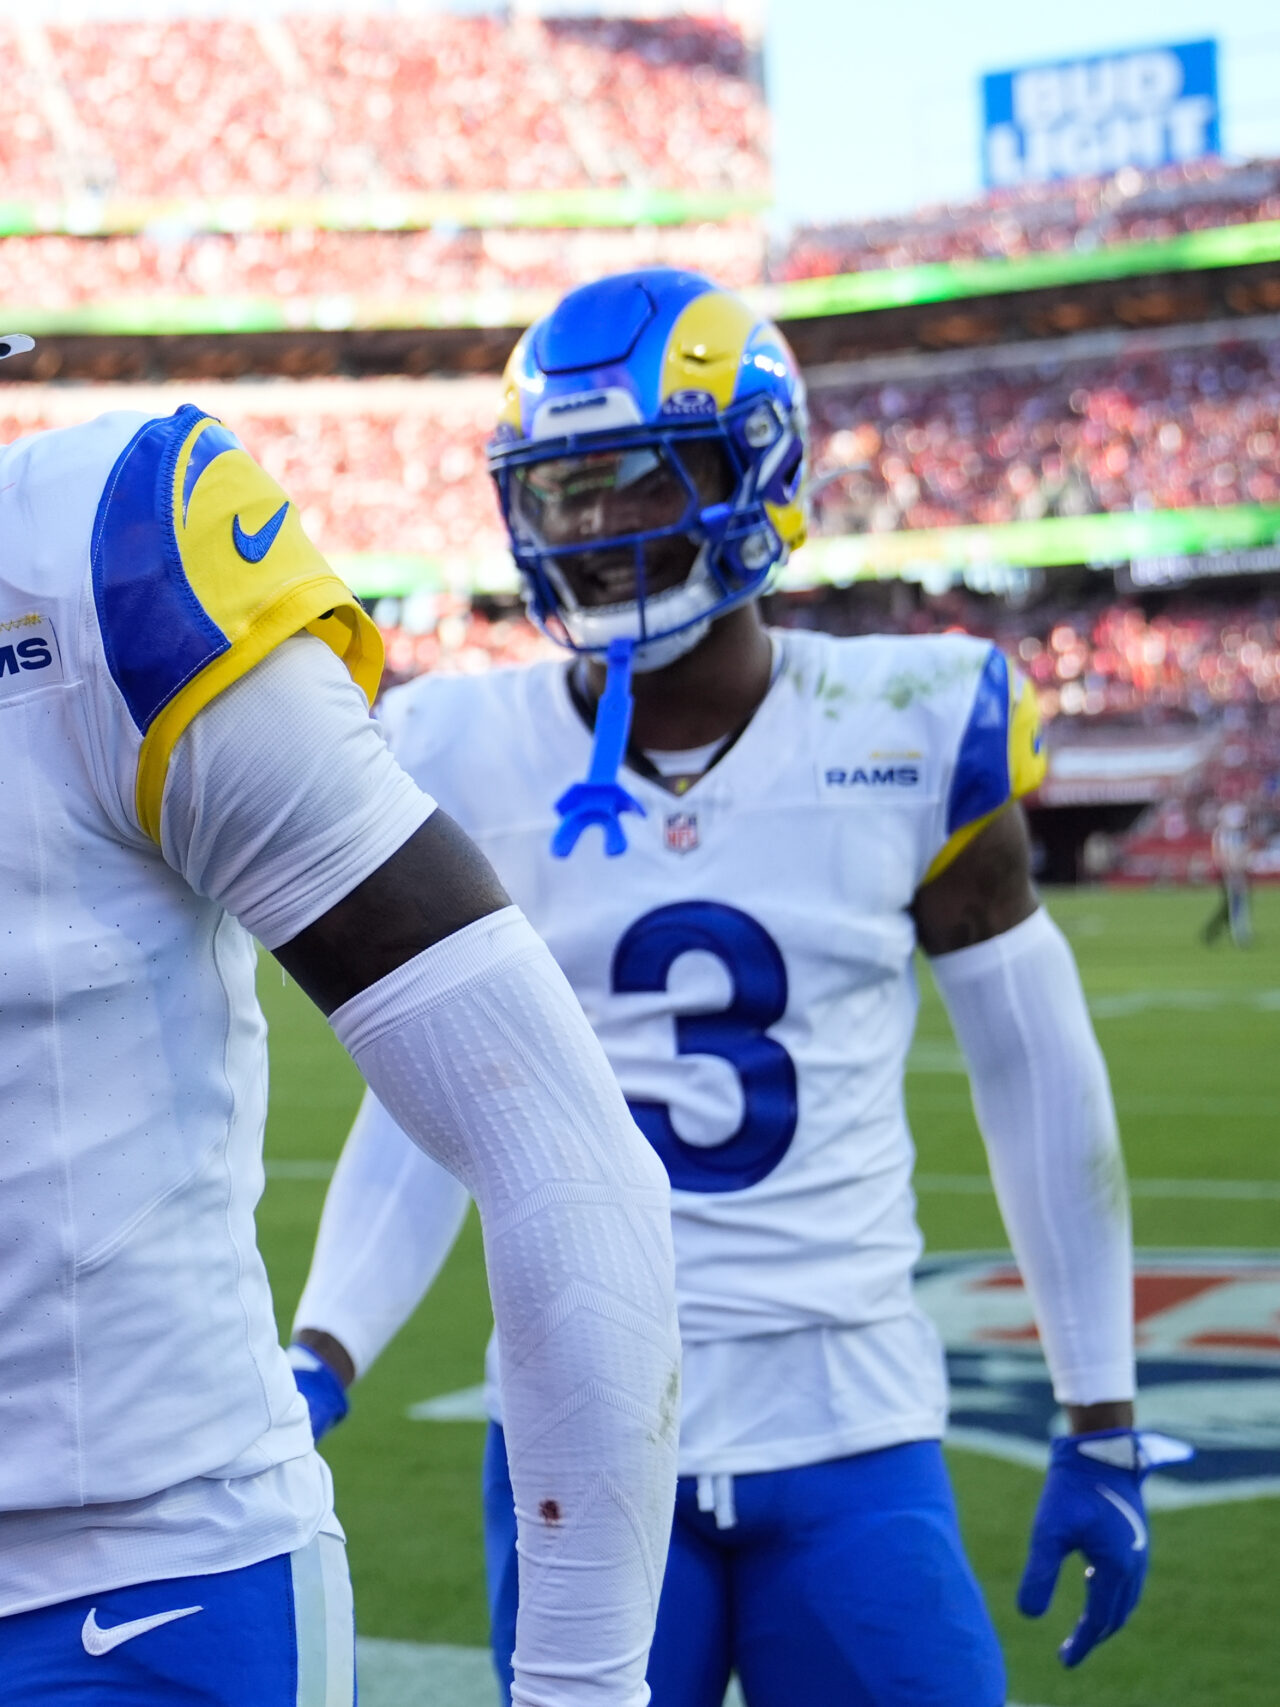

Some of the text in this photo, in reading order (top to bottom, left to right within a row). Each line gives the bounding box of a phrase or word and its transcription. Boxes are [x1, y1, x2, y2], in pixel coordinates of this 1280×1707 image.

[1012, 50, 1184, 130] BUD
[987, 95, 1213, 186] LIGHT
[825, 768, 919, 787] RAMS
[668, 826, 699, 848] NFL
[610, 900, 798, 1193] 3
